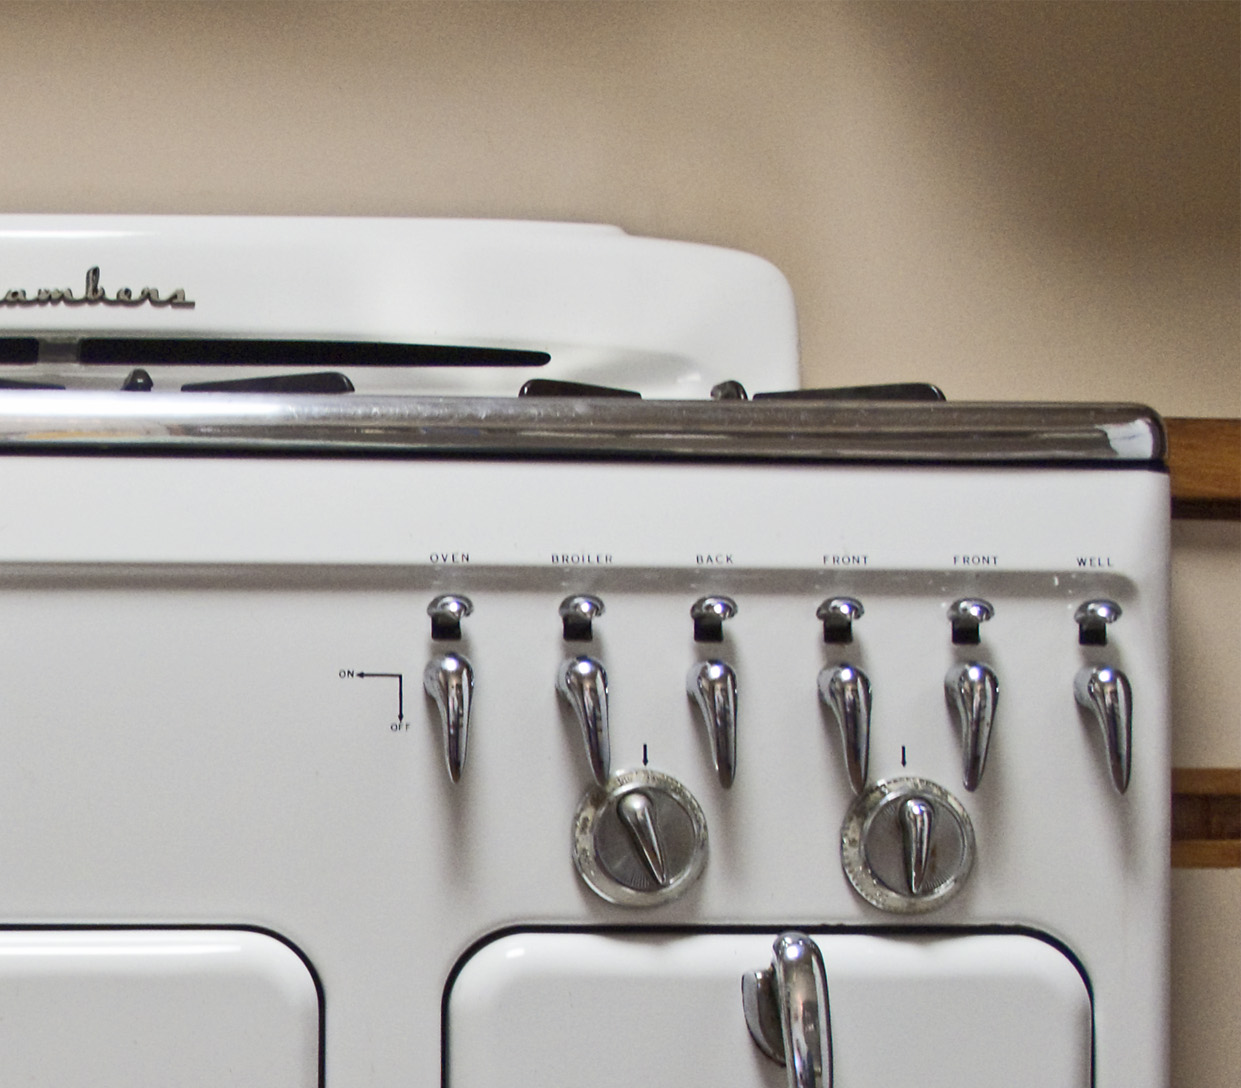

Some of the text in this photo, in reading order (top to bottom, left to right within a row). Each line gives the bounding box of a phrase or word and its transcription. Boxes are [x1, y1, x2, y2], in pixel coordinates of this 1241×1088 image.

[429, 552, 470, 564] OVEN
[551, 553, 613, 564] BROILER
[696, 554, 733, 565] BACK
[823, 555, 869, 565] FRONT
[953, 555, 999, 565] FRONT
[1076, 556, 1114, 568] WELL
[338, 669, 355, 679] ON
